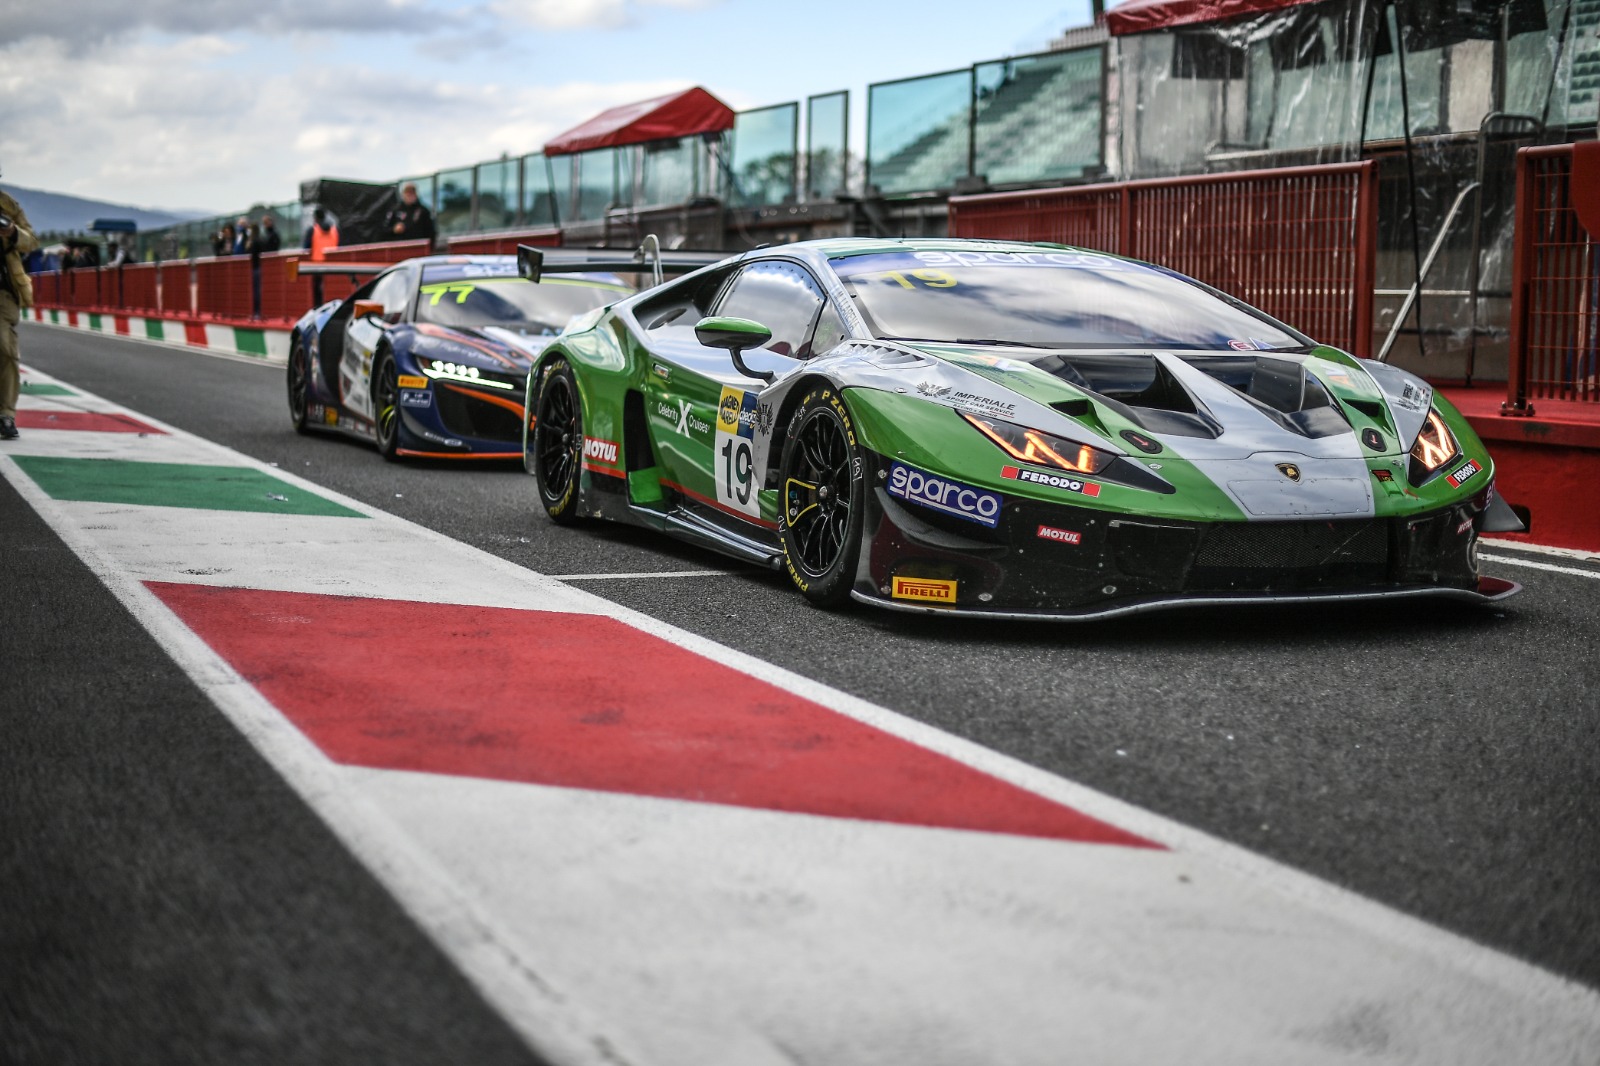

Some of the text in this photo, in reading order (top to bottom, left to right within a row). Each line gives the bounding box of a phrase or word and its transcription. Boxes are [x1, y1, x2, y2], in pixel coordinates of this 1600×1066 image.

[915, 251, 1112, 267] sparco
[879, 268, 958, 290] 19
[420, 285, 476, 306] 77
[946, 395, 1015, 417] SPORT CAR SERVICE
[954, 391, 1016, 411] IMPERIALE
[658, 402, 679, 424] Celebrity
[688, 416, 710, 435] Cruises
[584, 438, 617, 463] MOTUL
[721, 438, 753, 506] 19
[1021, 470, 1081, 491] FERODO
[1453, 463, 1476, 482] FERODO
[892, 466, 998, 517] sparco
[1040, 527, 1079, 544] MOTUL
[897, 578, 950, 599] PIRELLI
